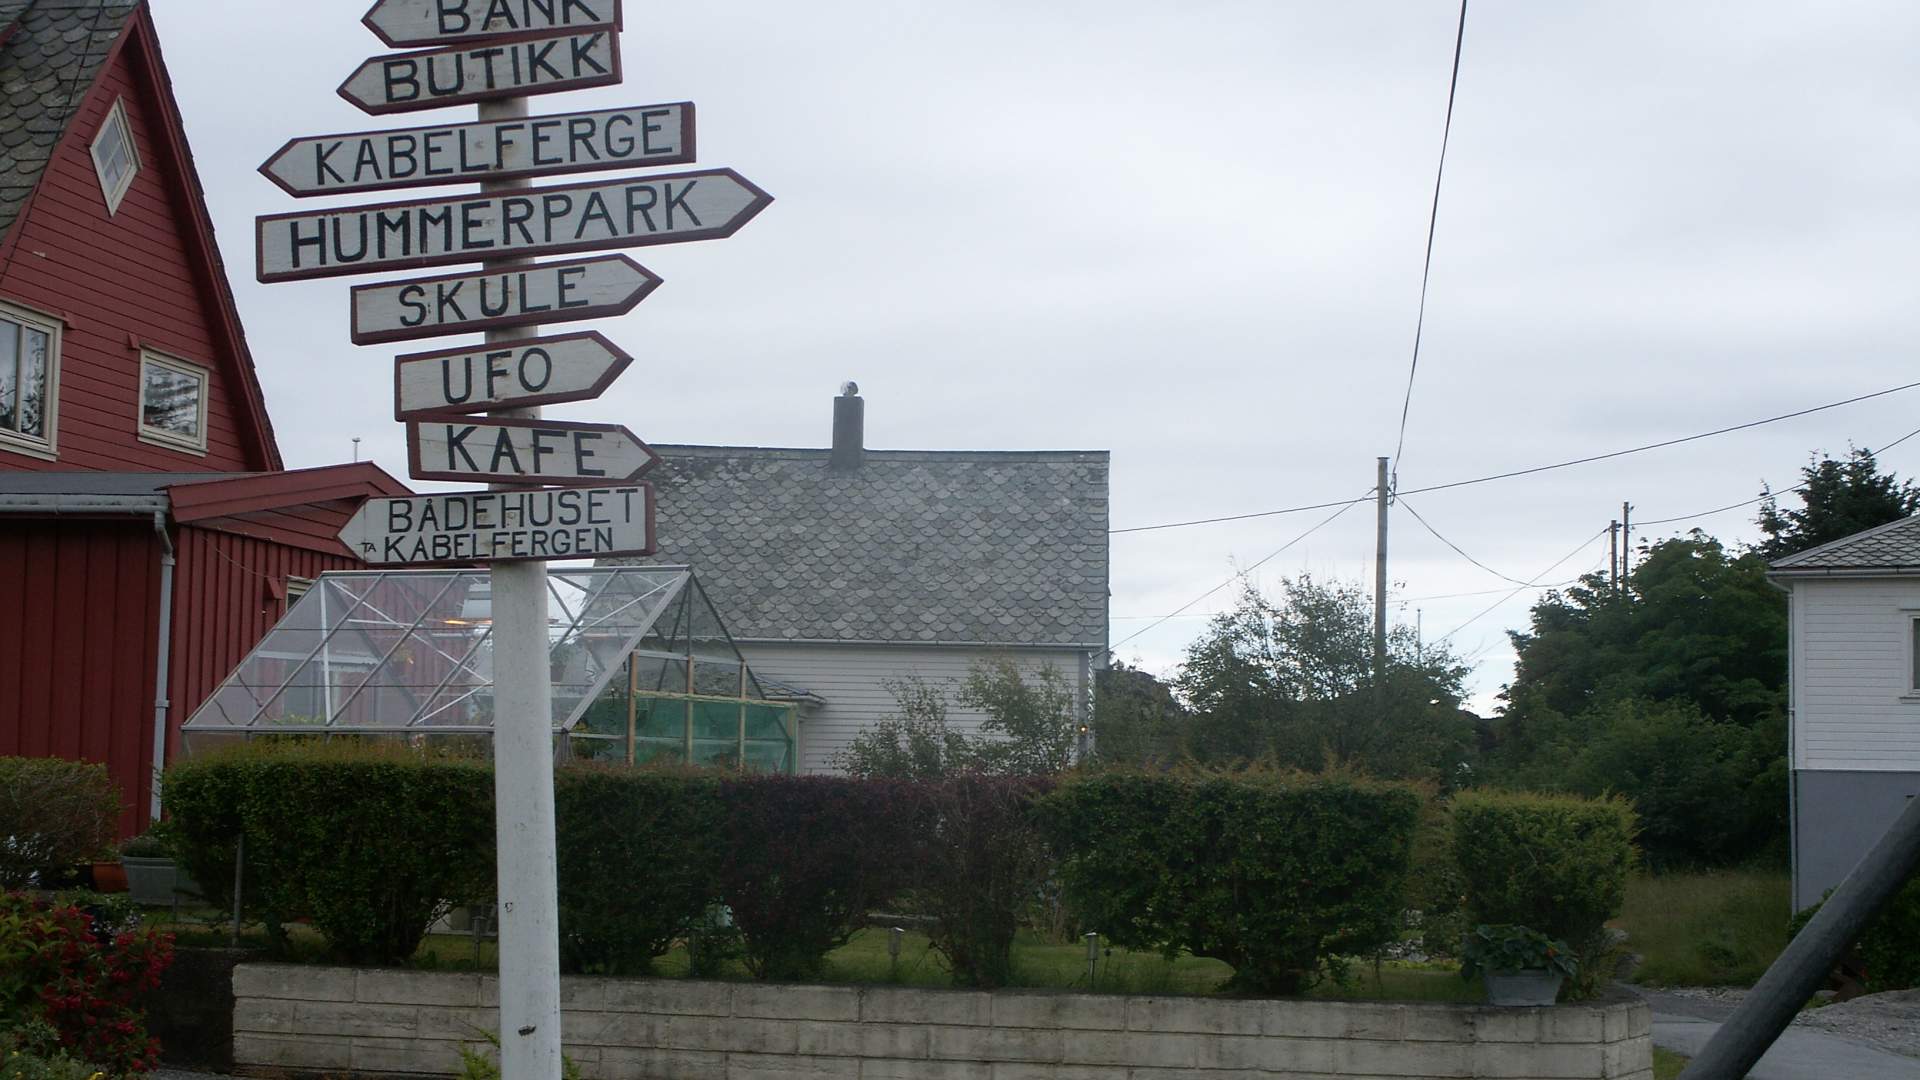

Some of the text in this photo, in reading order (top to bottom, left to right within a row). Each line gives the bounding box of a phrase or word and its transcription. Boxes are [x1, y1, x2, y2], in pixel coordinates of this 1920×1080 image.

[438, 0, 600, 34] BANK
[384, 32, 608, 103] BUTIKK
[315, 109, 673, 186] KABELFERGE
[290, 180, 702, 268] HUMMERPARK
[399, 266, 589, 327] SKULE
[441, 346, 552, 404] UFO
[446, 425, 605, 476] KAFE
[388, 488, 638, 533] BÅDEHUSET
[384, 527, 613, 562] KABELFERGEN
